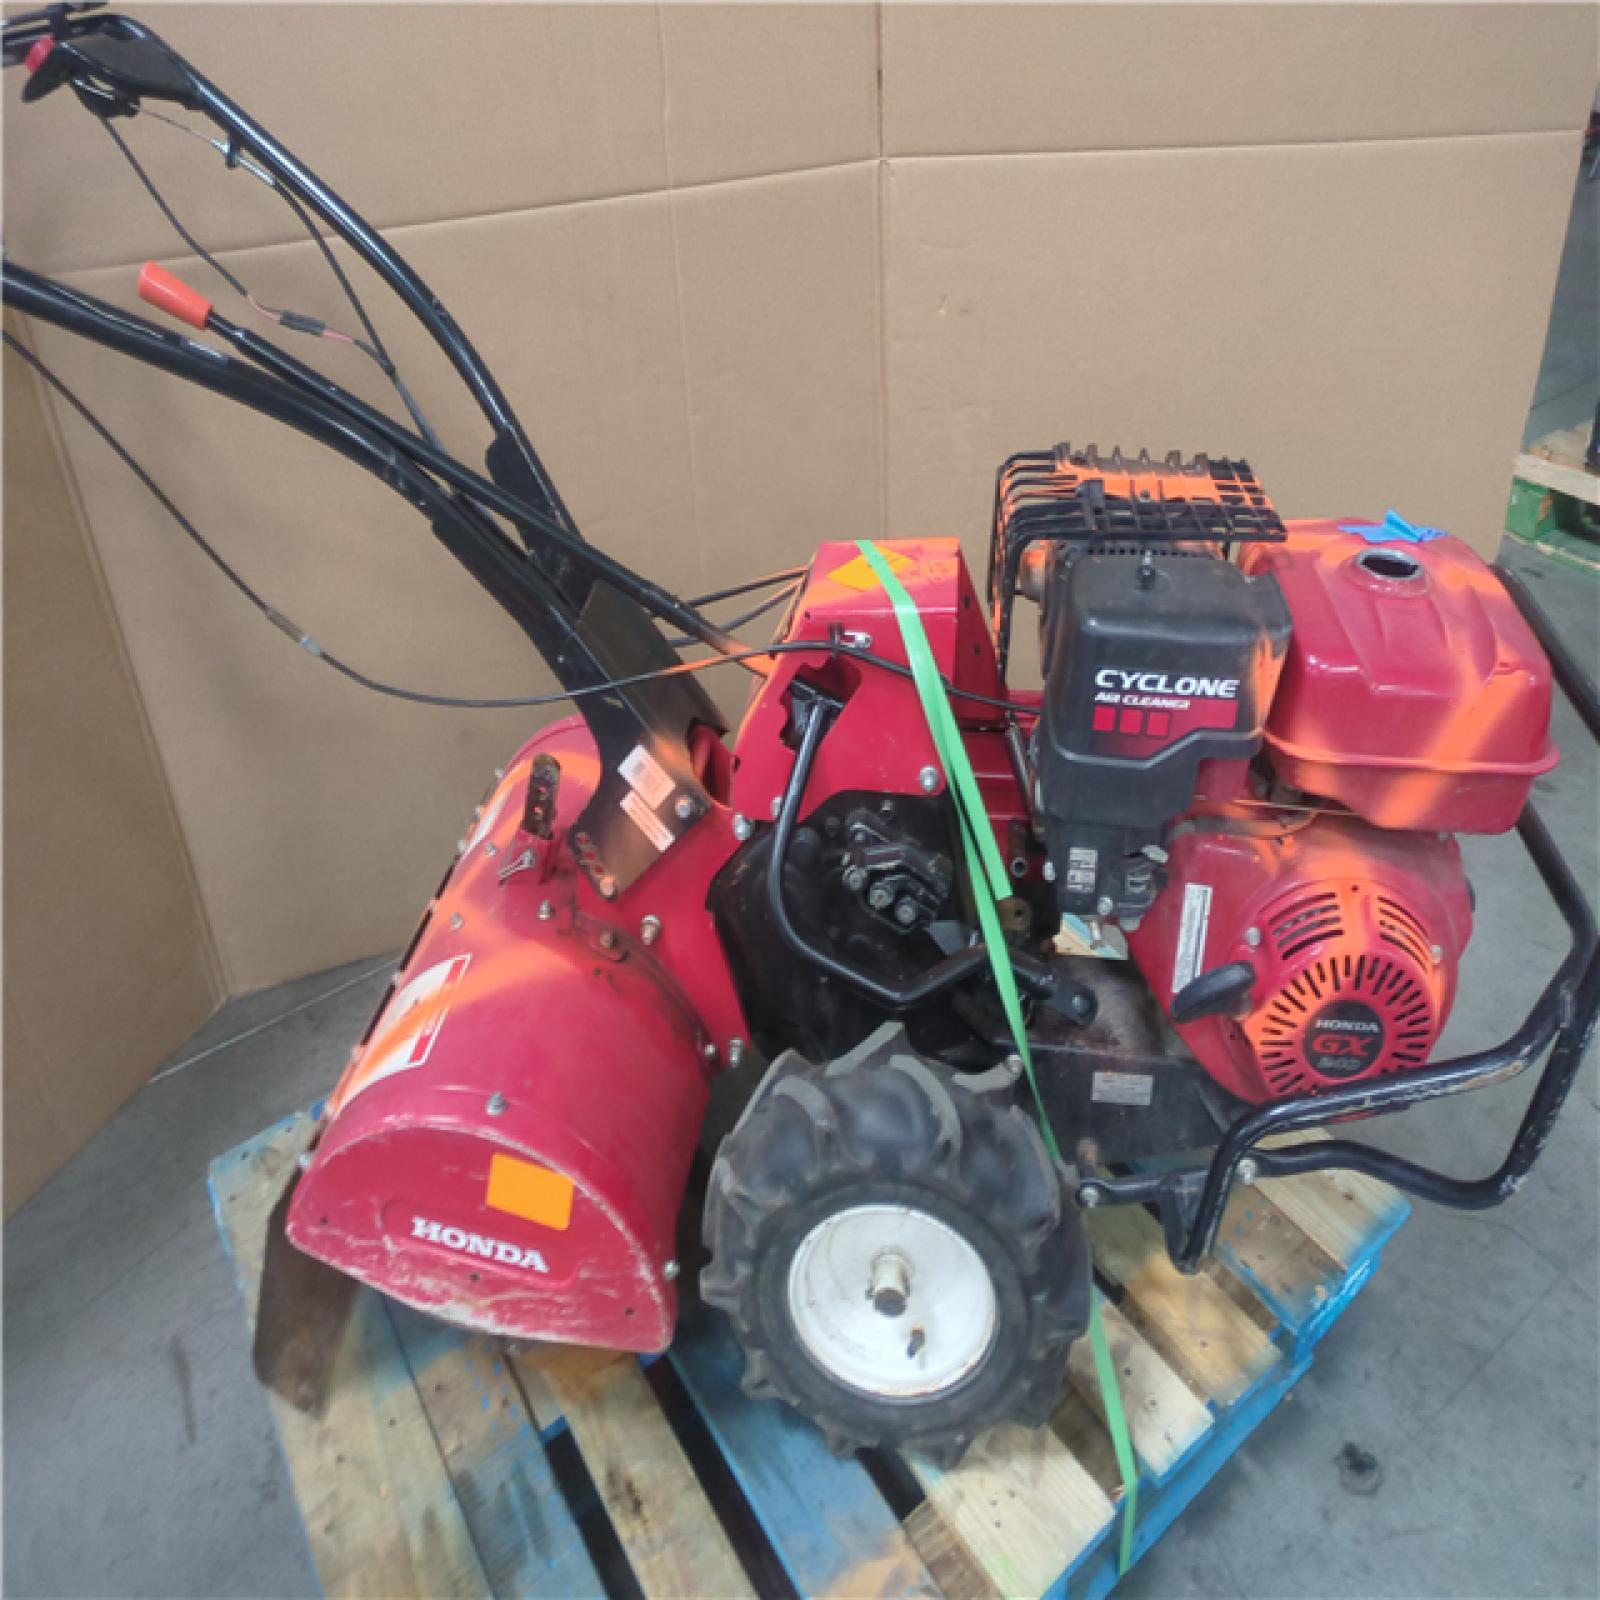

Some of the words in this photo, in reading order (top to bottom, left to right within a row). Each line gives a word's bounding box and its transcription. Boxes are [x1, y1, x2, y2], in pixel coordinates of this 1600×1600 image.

[1096, 669, 1240, 697] CYCLONE
[1095, 692, 1120, 703] AIR
[1122, 694, 1191, 709] CLEANER
[1315, 1019, 1379, 1033] HONDA
[1312, 1034, 1373, 1056] GX
[411, 1216, 549, 1273] HONDA
